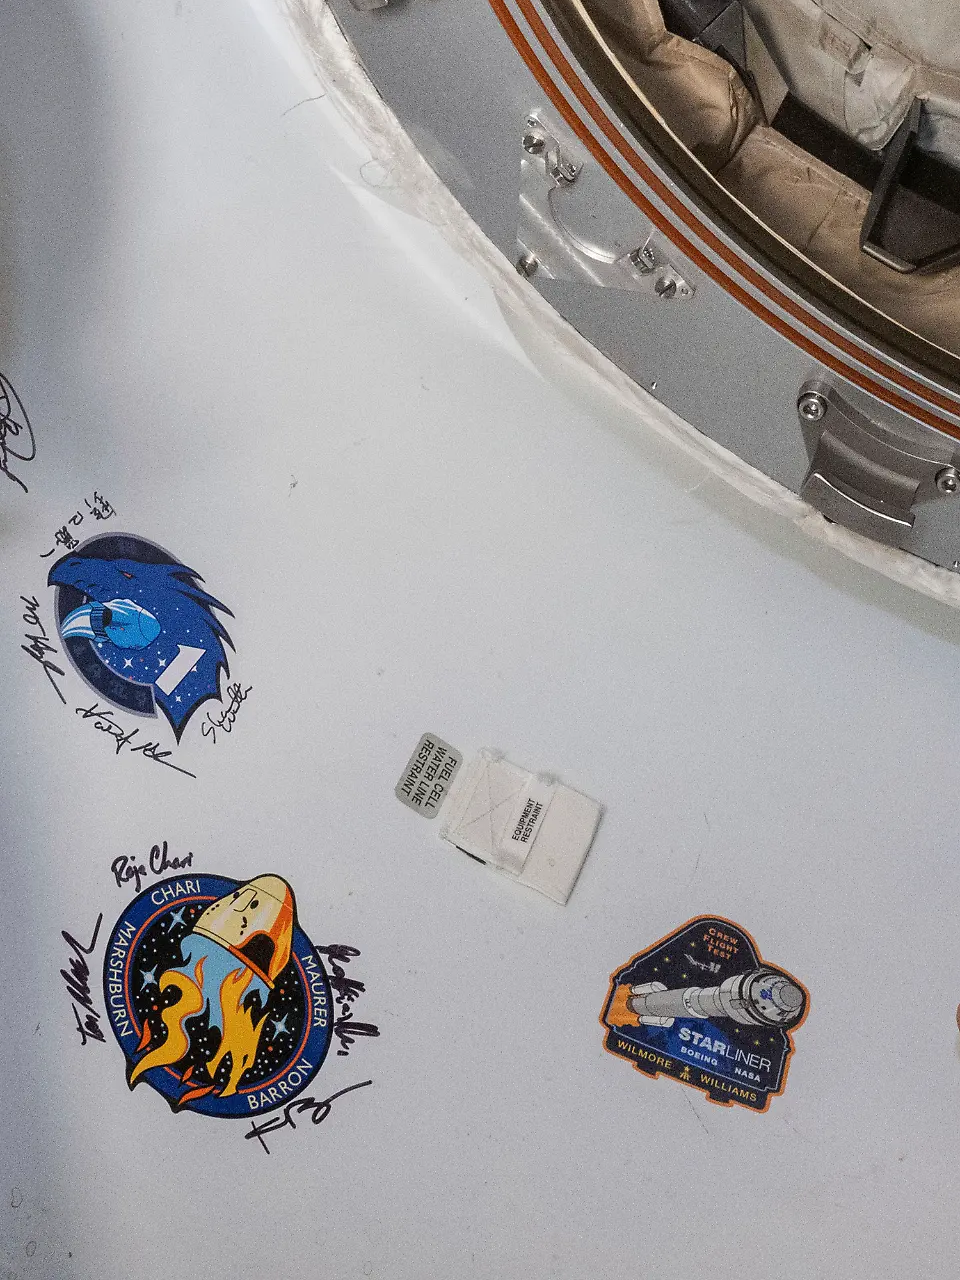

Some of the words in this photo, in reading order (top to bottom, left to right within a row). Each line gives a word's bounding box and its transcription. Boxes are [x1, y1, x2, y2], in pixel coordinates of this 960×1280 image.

[401, 739, 435, 797] RESTRAINT
[424, 746, 447, 782] WATER
[438, 756, 458, 782] FUEL
[411, 781, 430, 806] LINE
[424, 783, 444, 809] CELL
[511, 797, 536, 841] EQUIPMENT
[520, 802, 544, 844] RESTRAINT
[151, 880, 201, 905] CHARI
[703, 933, 739, 954] FLIGHT
[709, 927, 738, 945] CREW
[707, 944, 732, 960] TEST
[108, 920, 137, 1037] MARSHBURN
[301, 954, 328, 1029] MAURER
[678, 1027, 772, 1073] STARLINER
[680, 1046, 718, 1066] BOEING
[247, 1057, 313, 1110] BARRON
[617, 1039, 673, 1070] WILMORE
[700, 1074, 757, 1102] WILLIAMS
[734, 1067, 761, 1083] NASA
